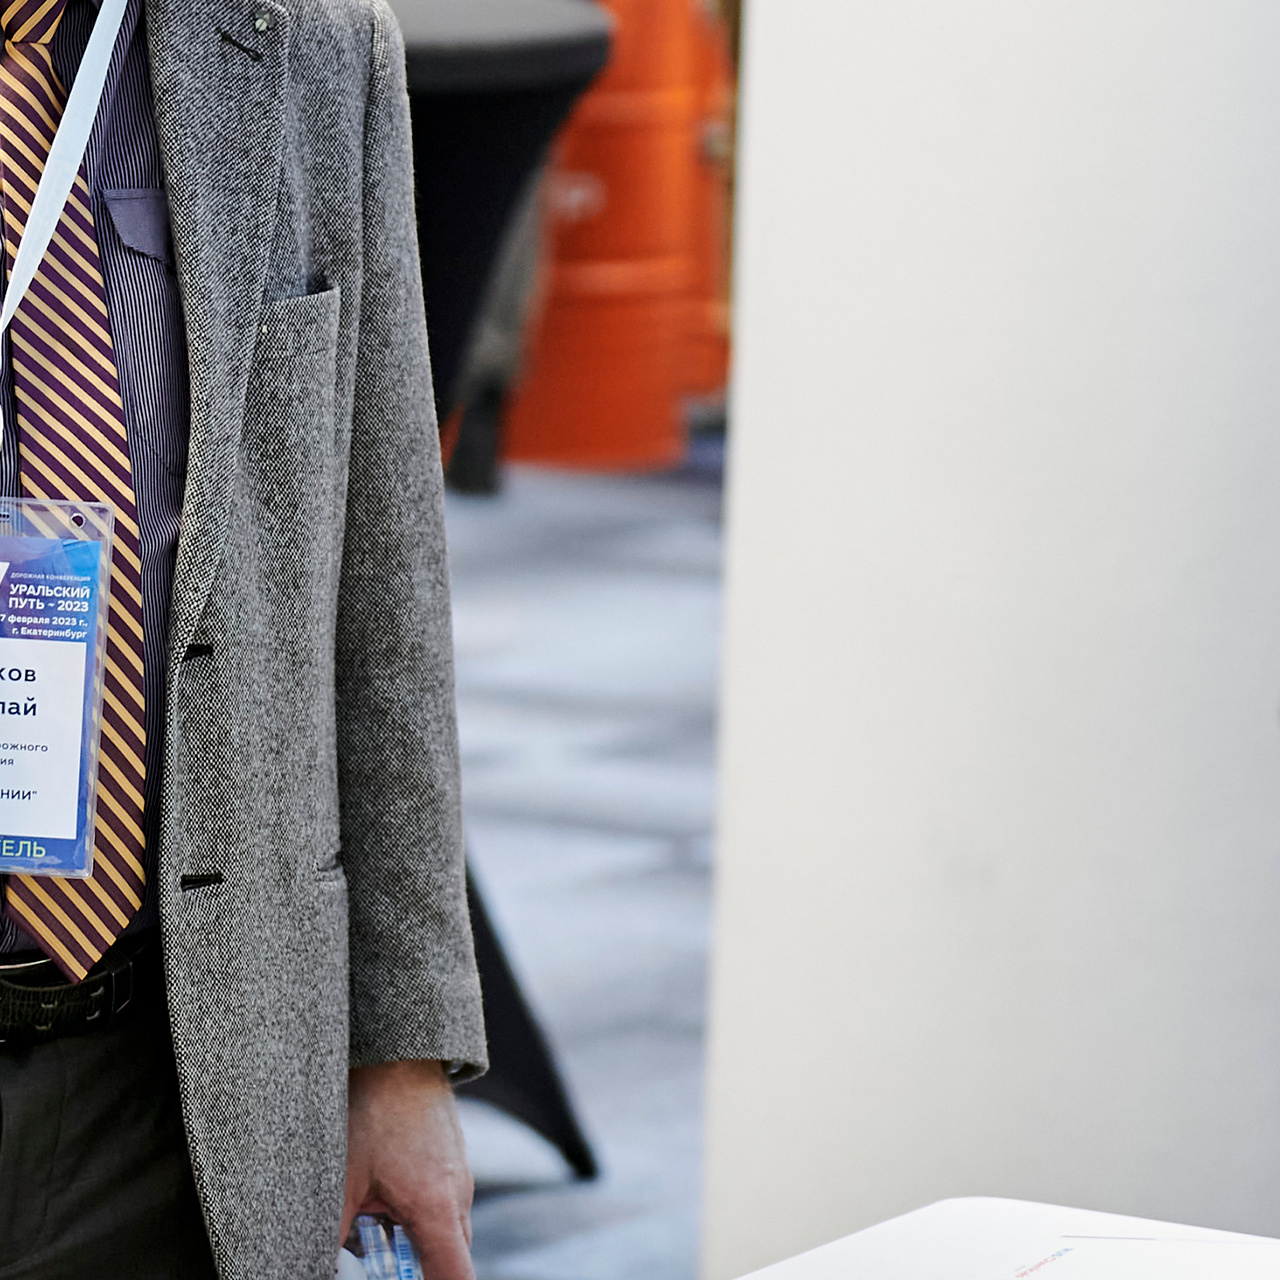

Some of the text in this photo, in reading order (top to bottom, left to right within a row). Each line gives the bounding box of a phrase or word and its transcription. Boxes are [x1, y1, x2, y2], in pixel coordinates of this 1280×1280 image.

[10, 572, 45, 580] ДОРОЖНАЯ
[9, 583, 91, 599] УРАЛЬСКИЙ
[8, 597, 45, 610] ПУТЬ
[56, 600, 89, 613] 2023
[7, 615, 51, 626] февраля
[52, 616, 77, 626] 2023
[20, 626, 88, 639] Екатеринбург
